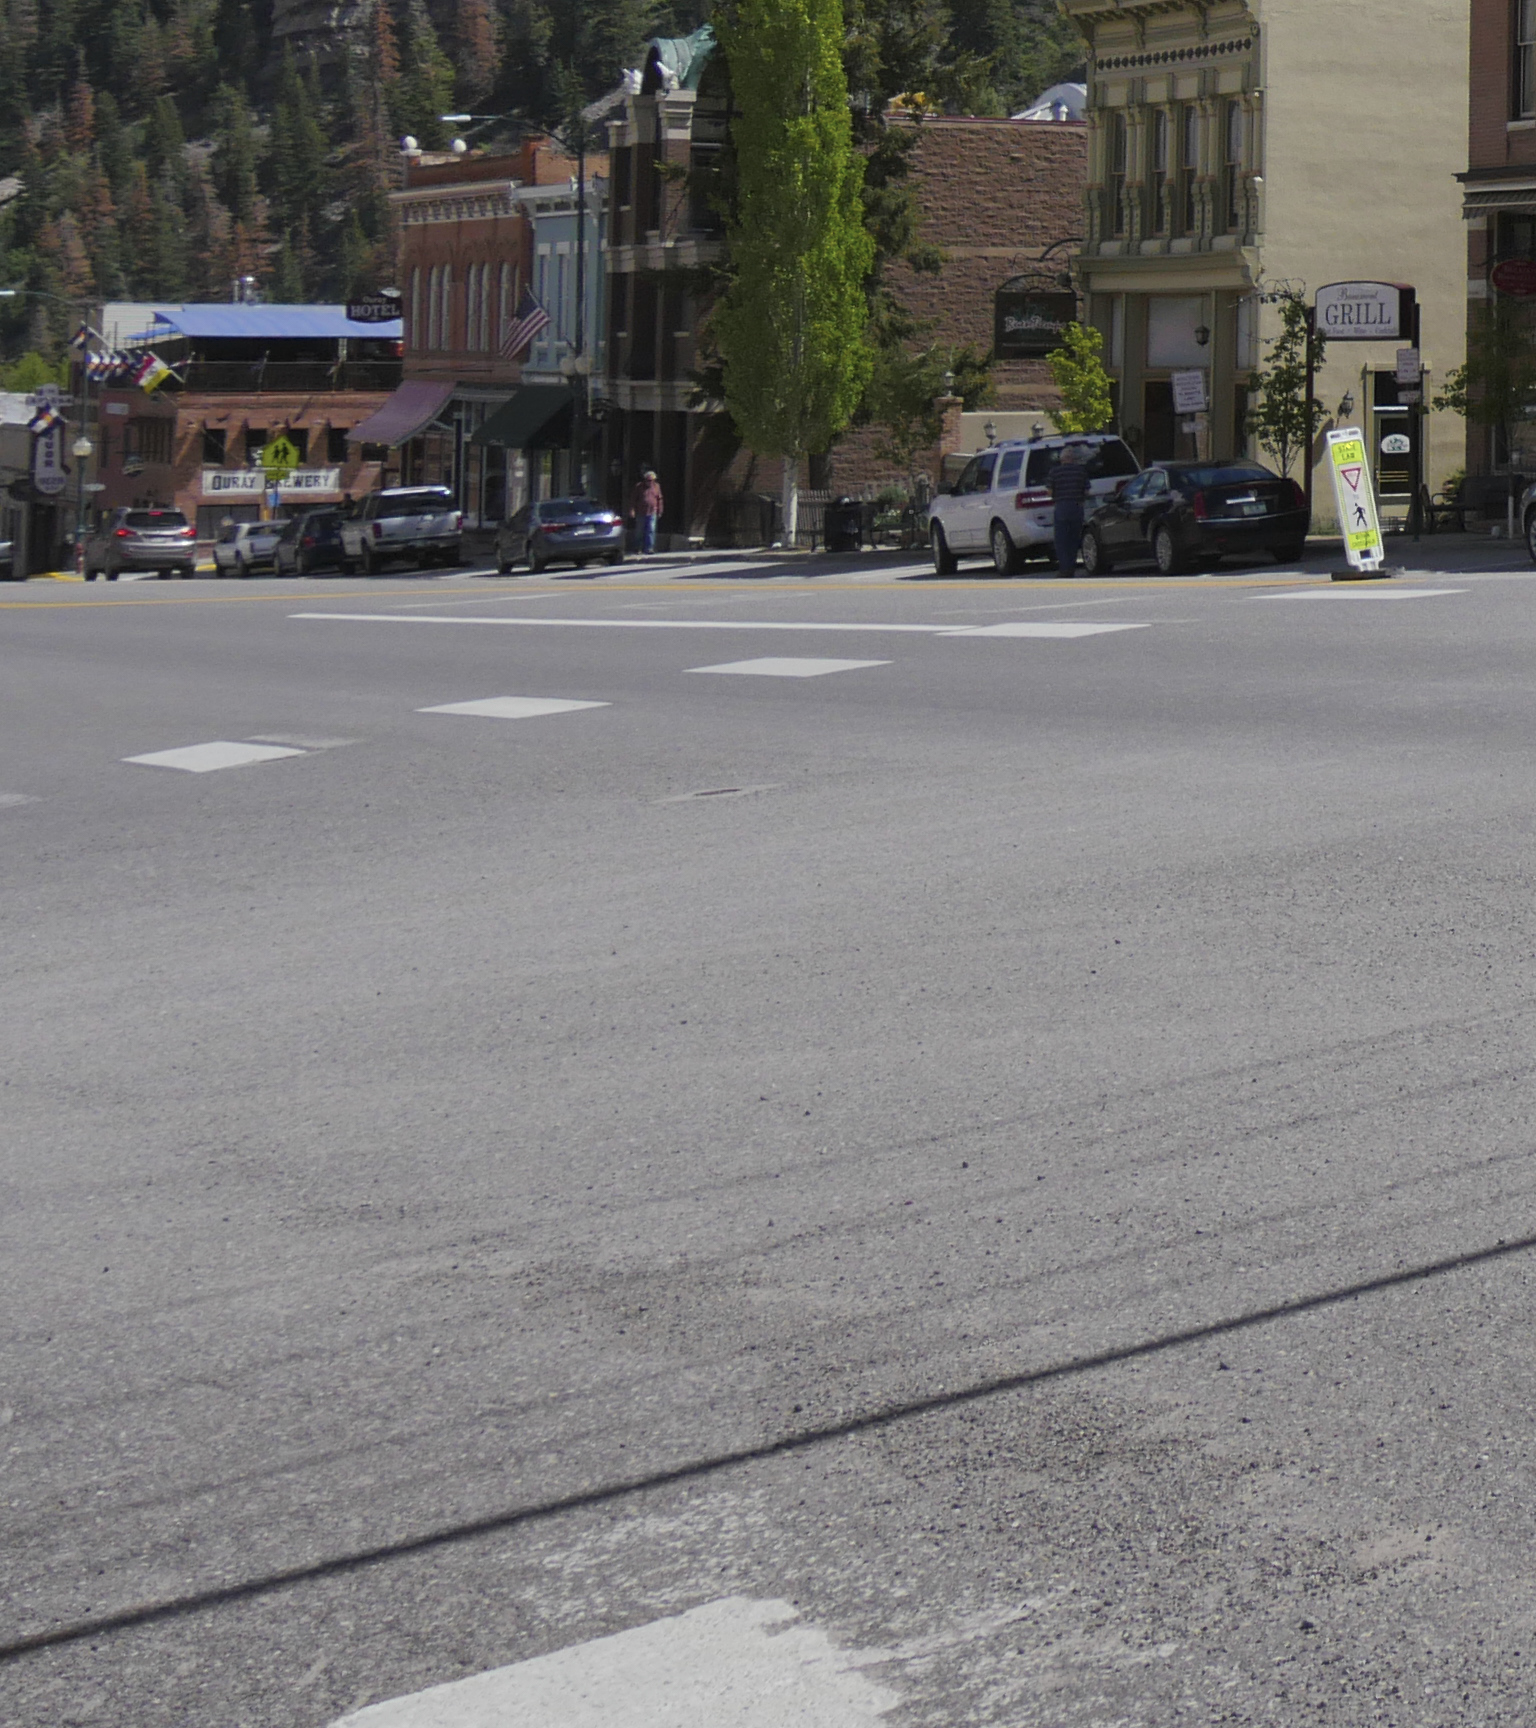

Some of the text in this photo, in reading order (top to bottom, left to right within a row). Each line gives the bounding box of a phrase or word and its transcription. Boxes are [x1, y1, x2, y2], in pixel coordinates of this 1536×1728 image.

[351, 304, 400, 317] HOTEL
[1325, 302, 1391, 326] GRILL
[212, 475, 256, 490] OURAY
